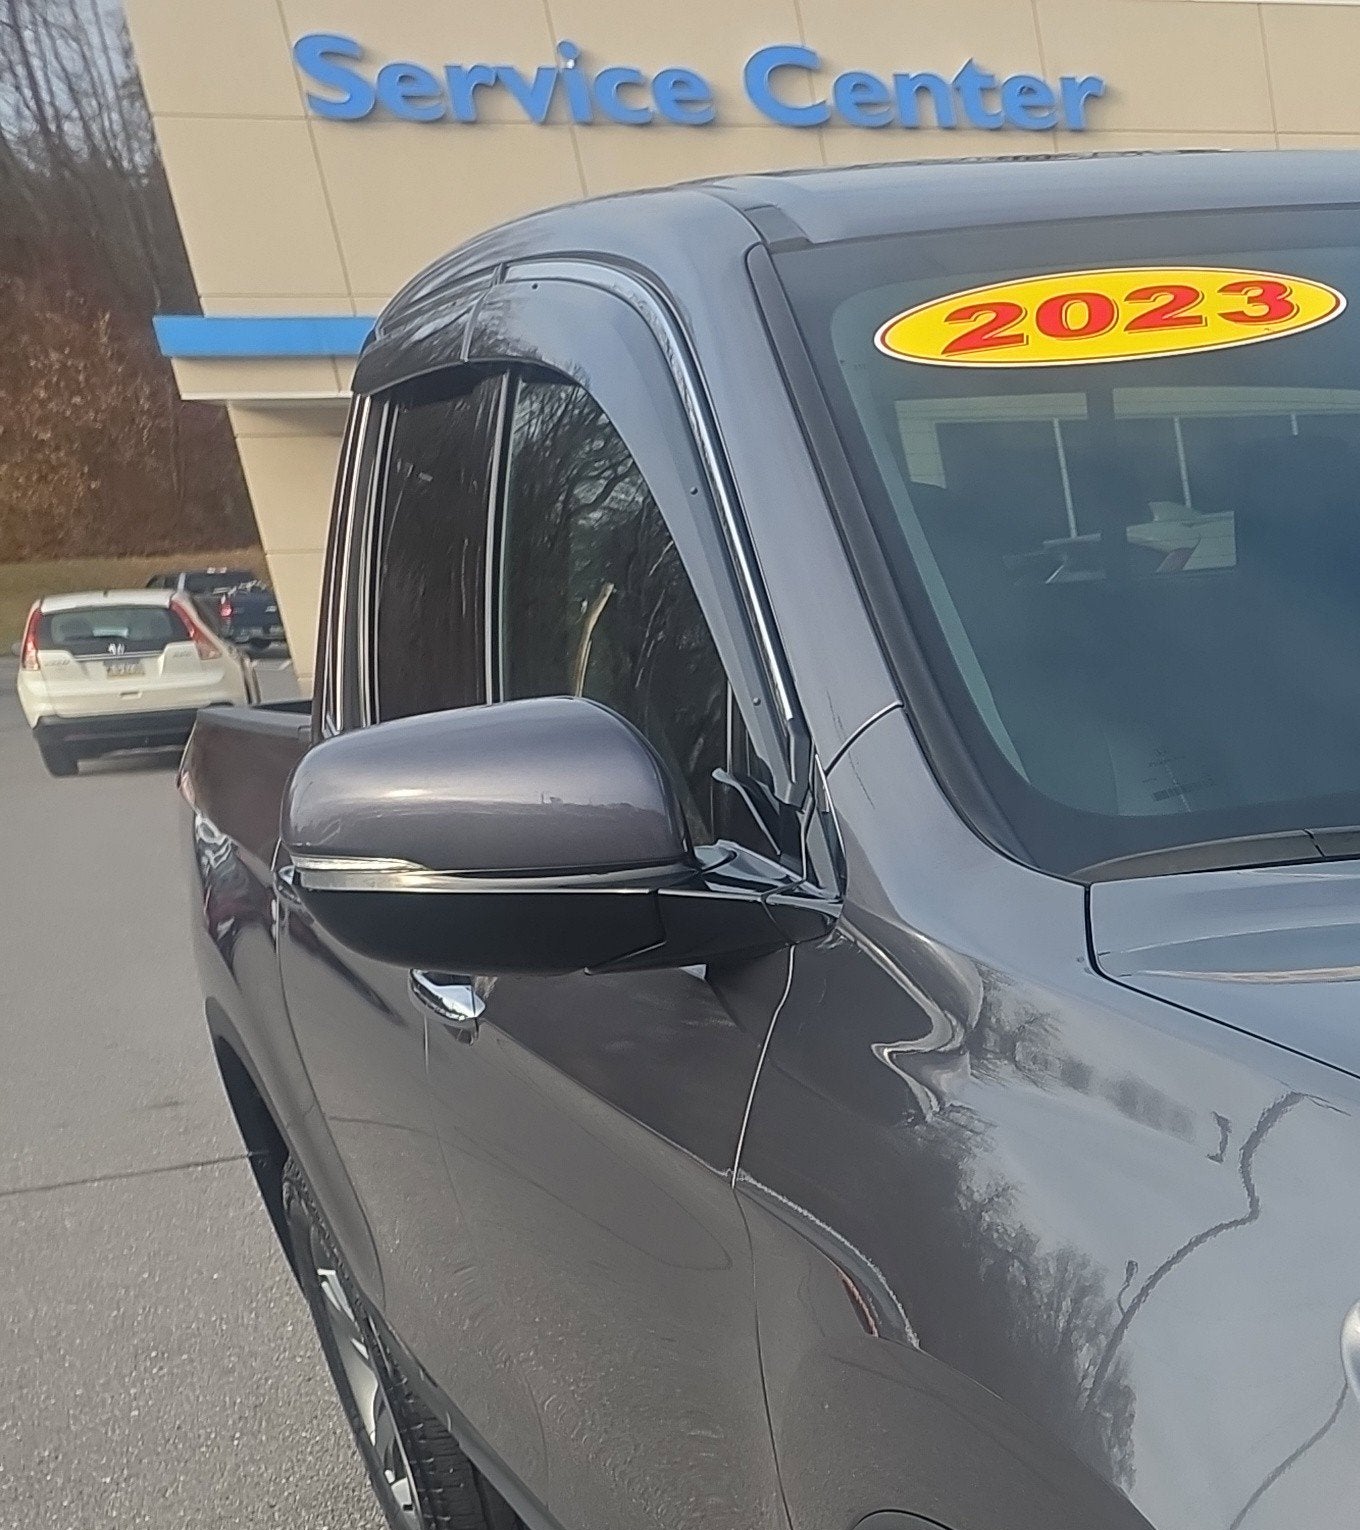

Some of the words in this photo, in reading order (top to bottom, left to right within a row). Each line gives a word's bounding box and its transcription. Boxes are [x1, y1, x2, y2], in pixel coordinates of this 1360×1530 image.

[292, 32, 716, 127] Service
[744, 44, 1106, 131] Center
[941, 280, 1299, 356] 2023
